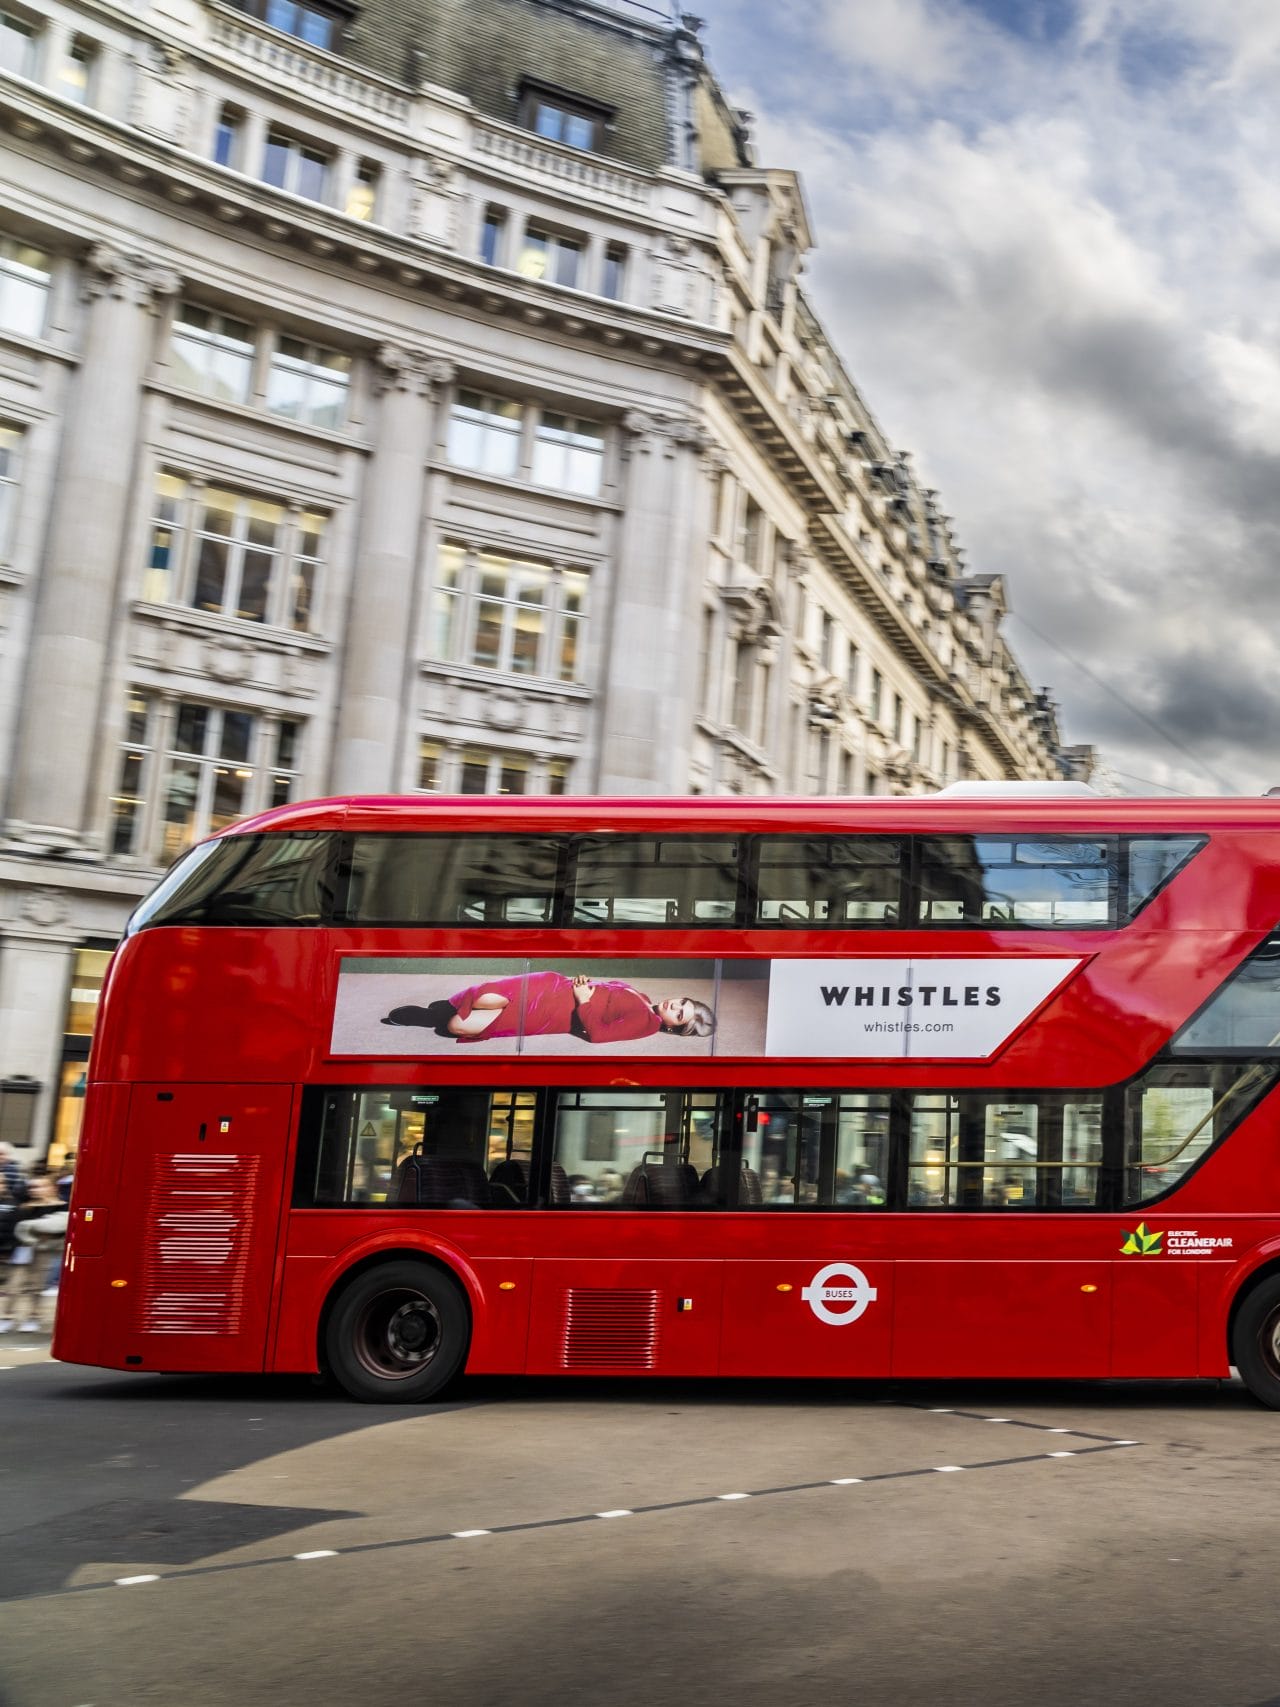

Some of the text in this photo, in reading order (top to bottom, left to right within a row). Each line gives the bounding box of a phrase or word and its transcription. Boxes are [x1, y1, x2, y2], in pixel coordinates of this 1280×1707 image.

[819, 985, 1002, 1007] WHISTLES
[863, 1021, 955, 1033] whistles.com
[825, 1290, 853, 1298] BUSES
